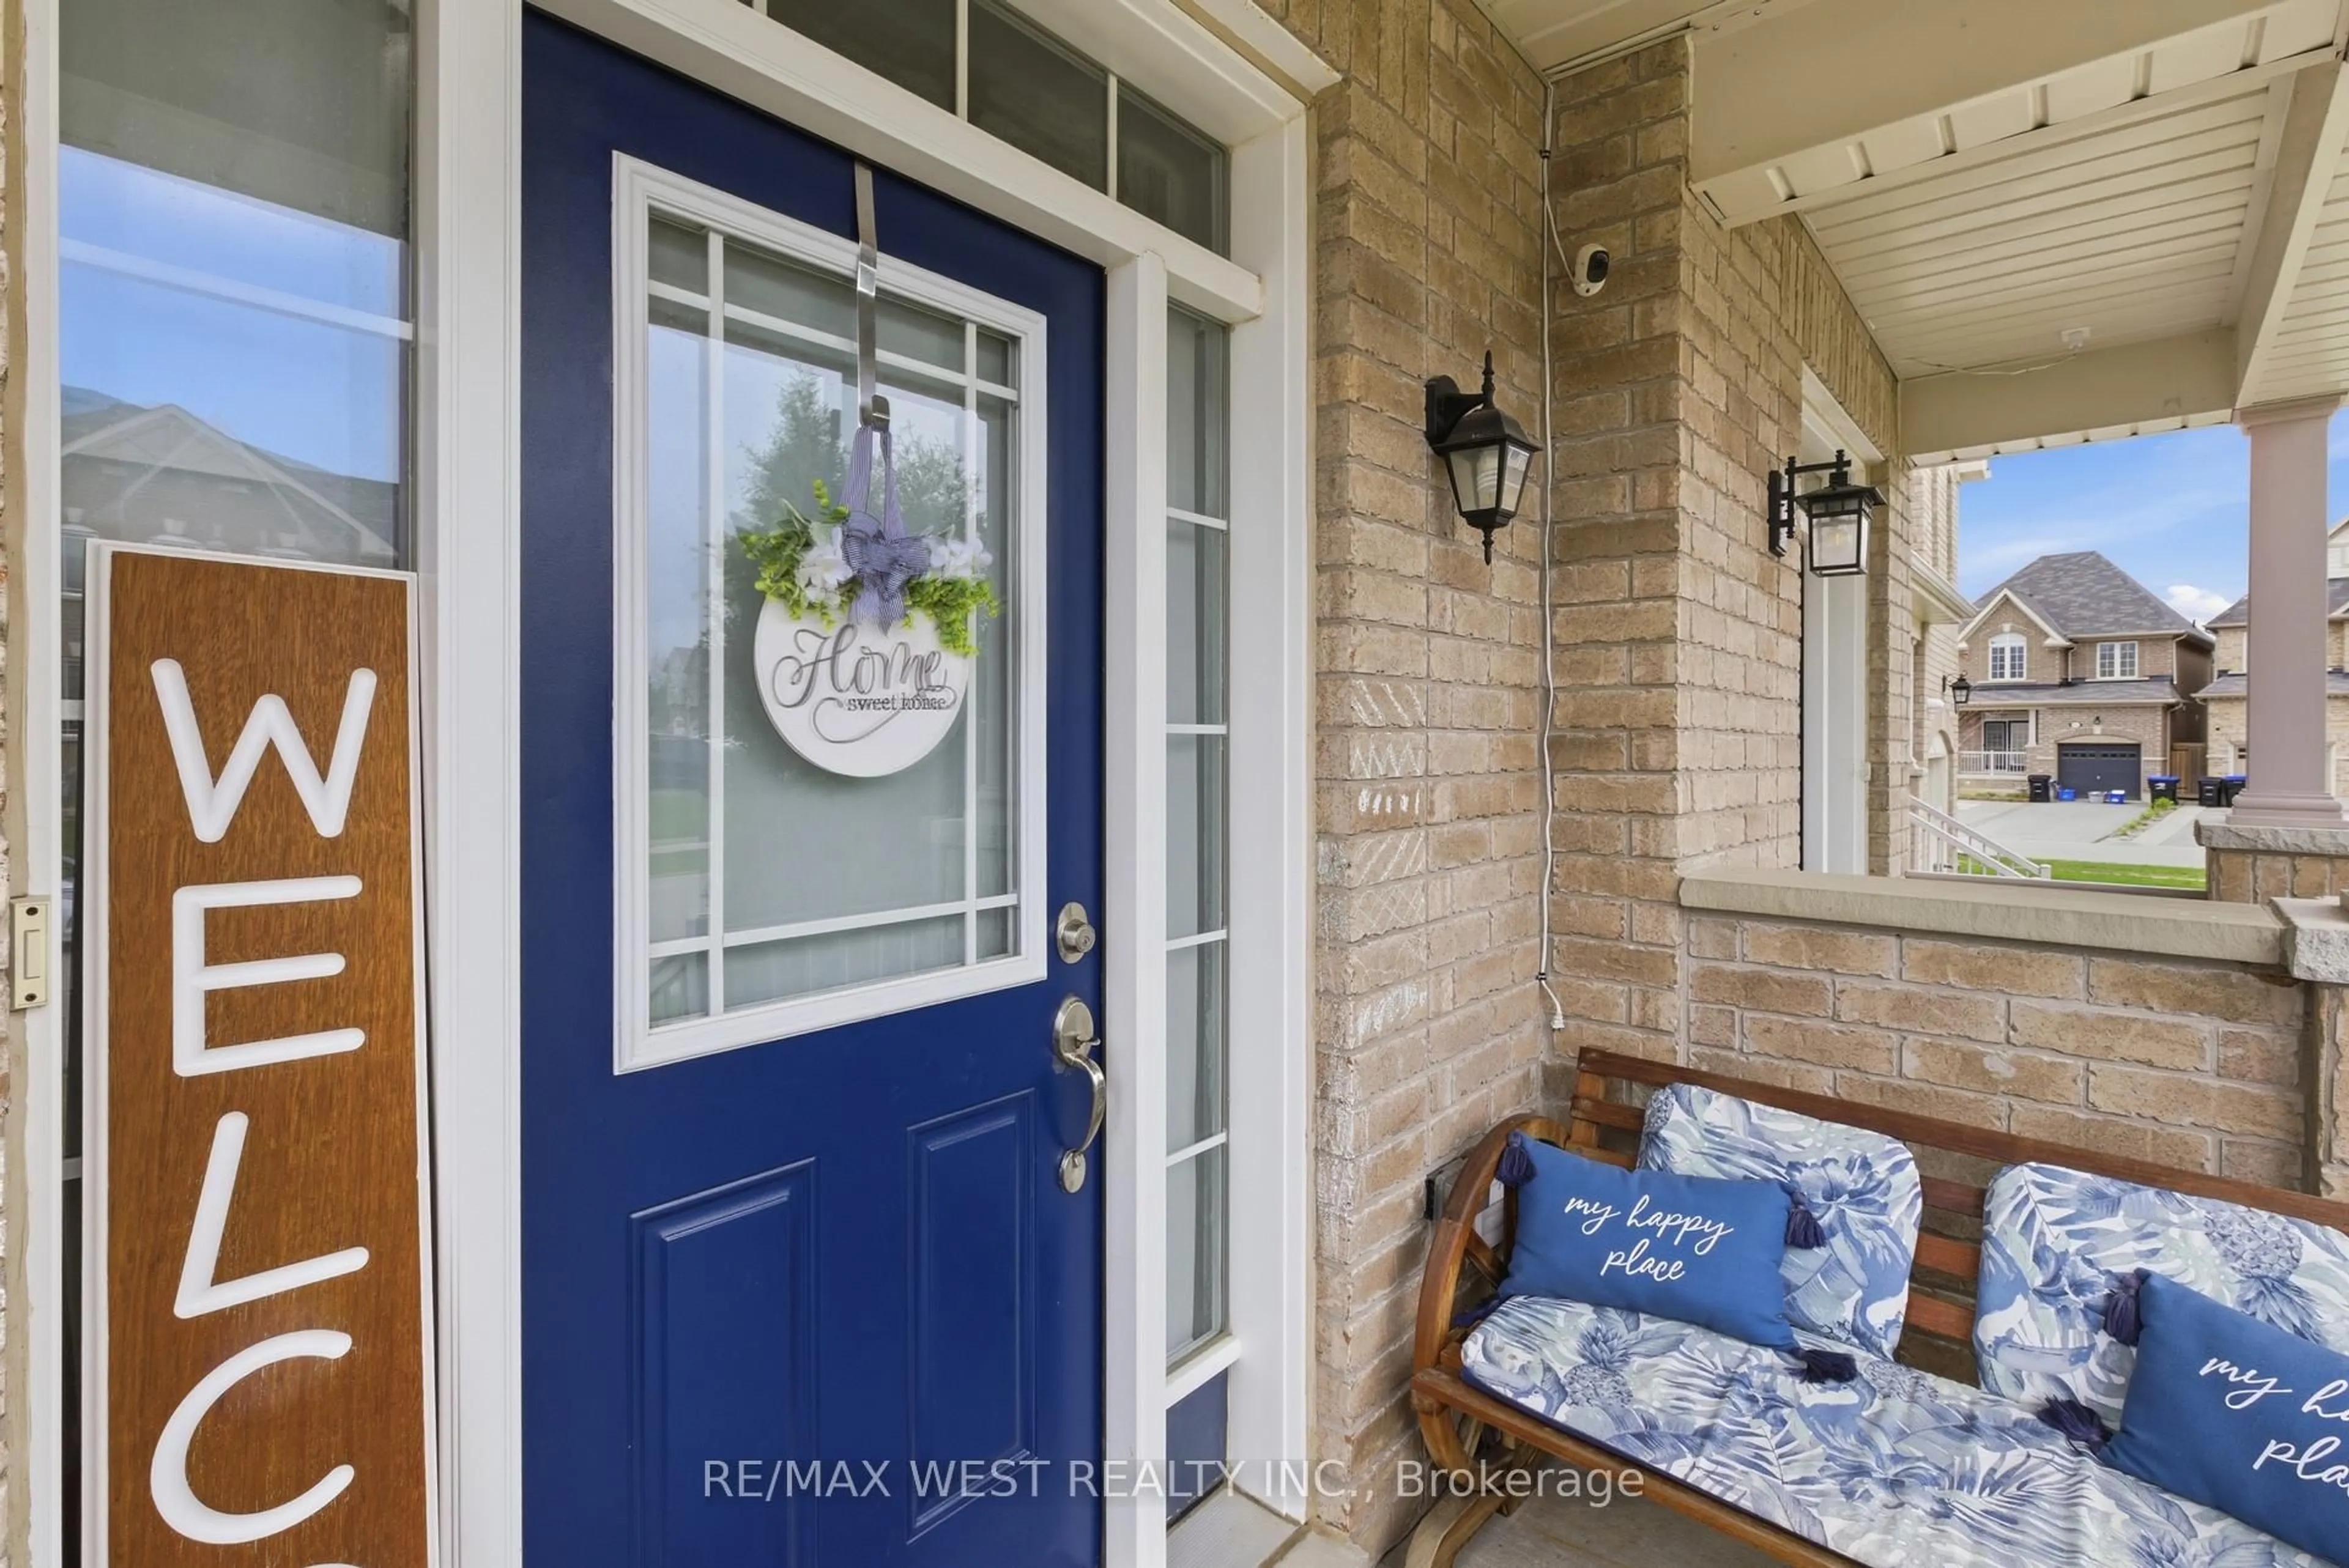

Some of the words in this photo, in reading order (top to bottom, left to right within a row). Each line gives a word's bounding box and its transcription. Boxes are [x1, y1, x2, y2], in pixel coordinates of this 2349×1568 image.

[773, 623, 949, 711] Home
[847, 695, 897, 711] sweet
[901, 692, 948, 711] home
[151, 657, 377, 1568] WELC
[1564, 1195, 1621, 1235] my
[1626, 1194, 1734, 1255] happy
[1600, 1238, 1685, 1281] place
[2199, 1357, 2293, 1409] my
[2301, 1379, 2349, 1421] h
[2252, 1436, 2349, 1498] pla
